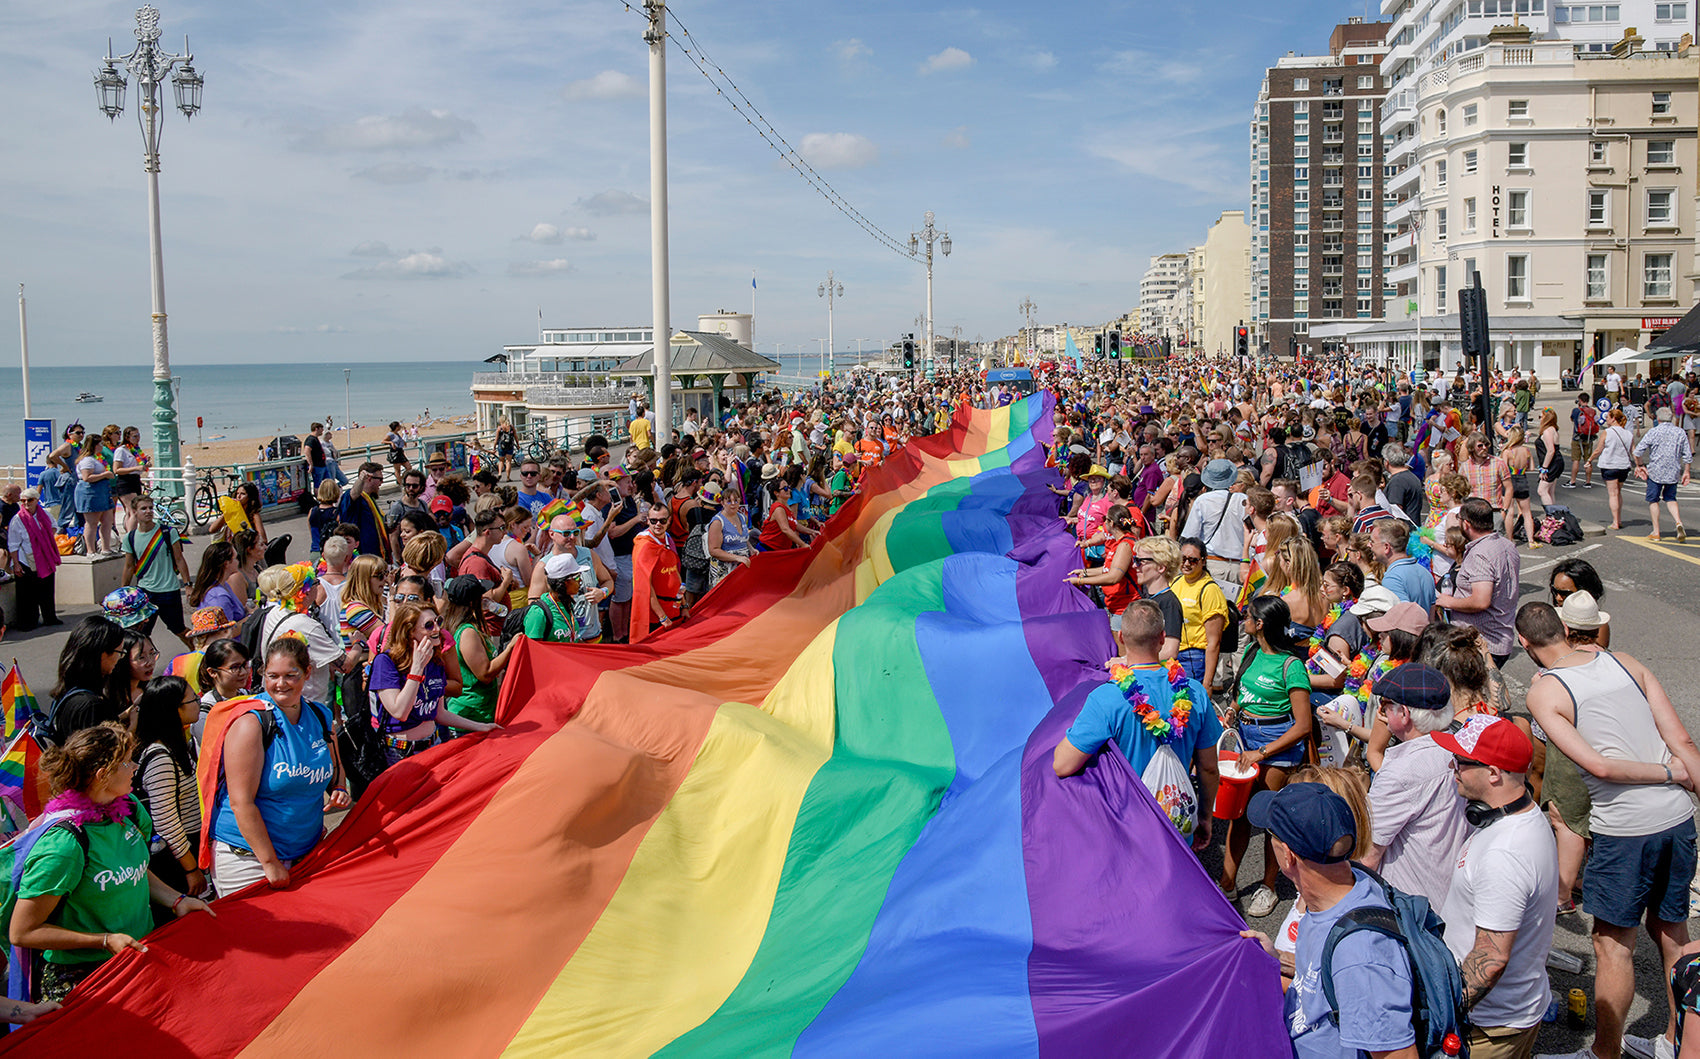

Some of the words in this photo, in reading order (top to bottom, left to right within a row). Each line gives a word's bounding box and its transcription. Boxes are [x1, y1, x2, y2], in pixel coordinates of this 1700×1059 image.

[1492, 185, 1500, 238] HOTEL
[274, 761, 310, 779] Pride
[93, 866, 134, 891] Pride
